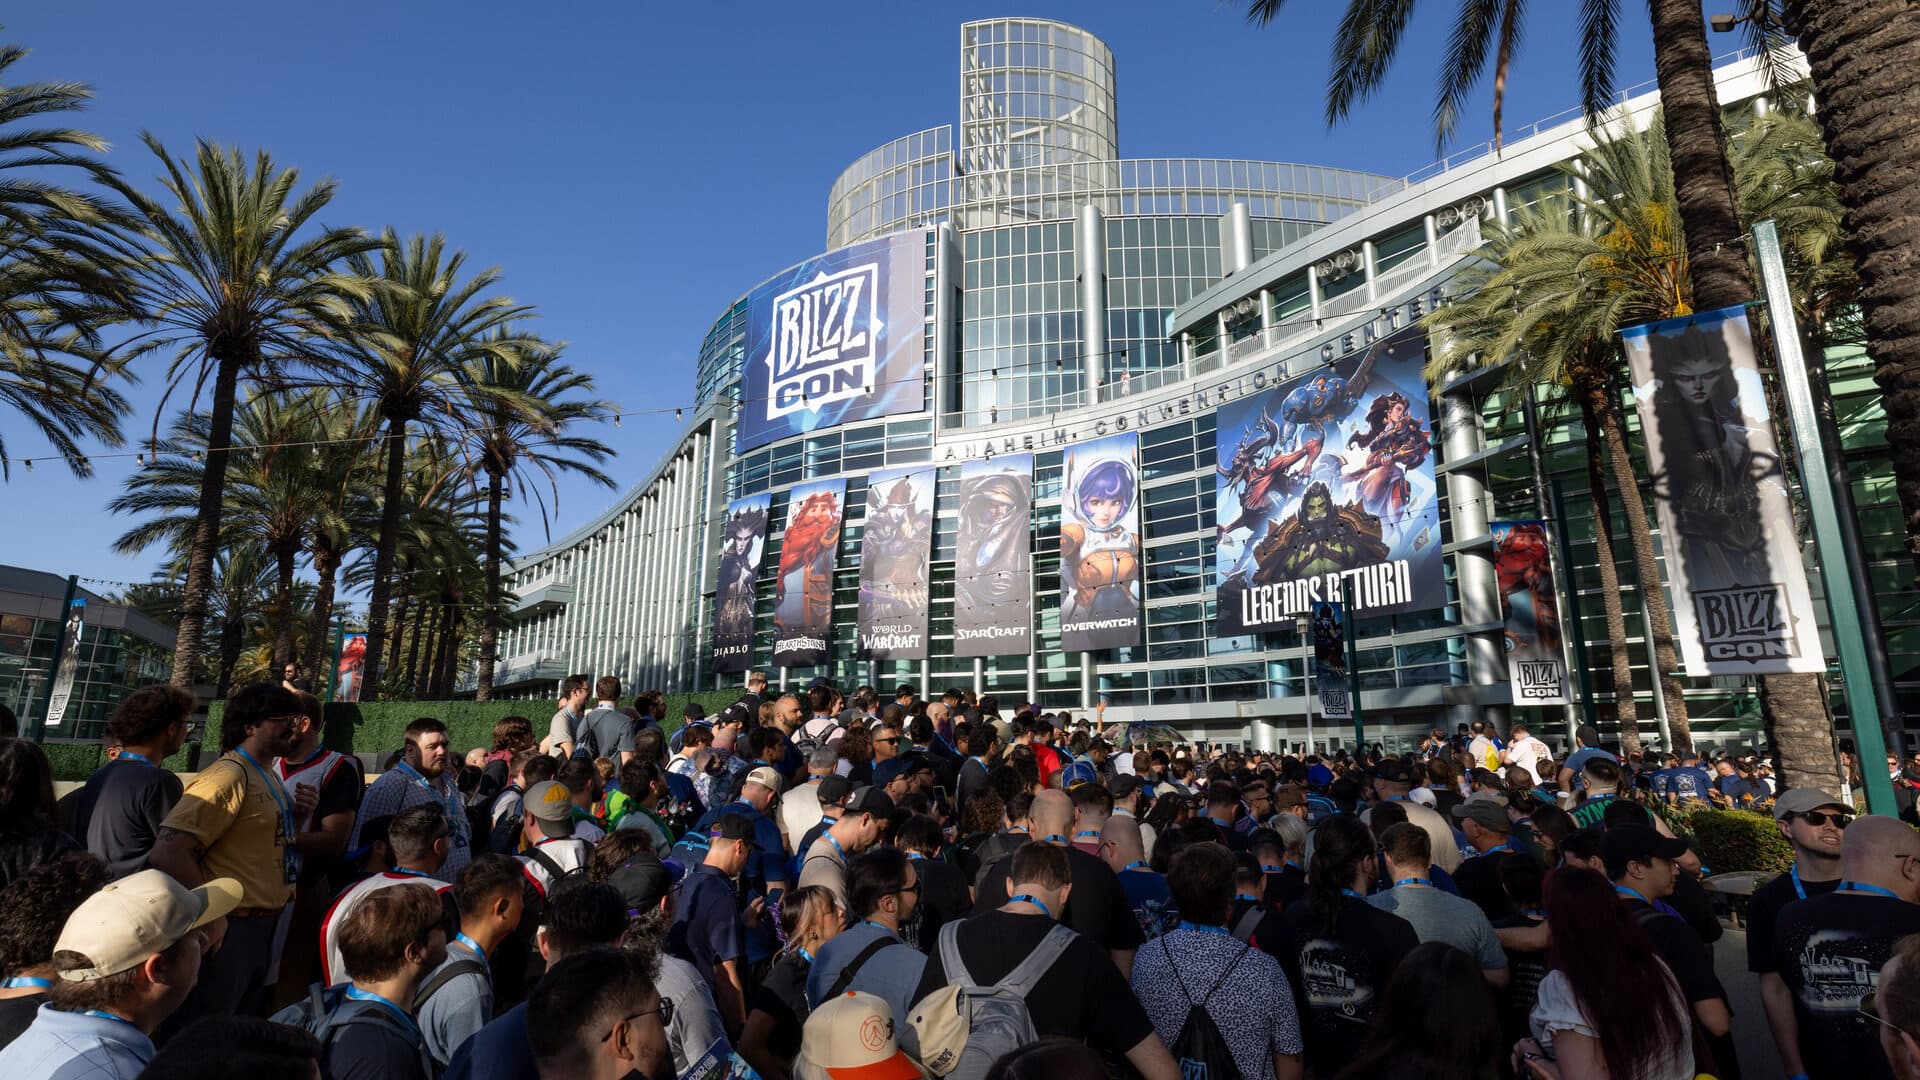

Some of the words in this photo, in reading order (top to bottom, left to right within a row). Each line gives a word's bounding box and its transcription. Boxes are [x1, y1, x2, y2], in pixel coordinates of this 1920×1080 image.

[777, 275, 866, 377] BLIZZ
[944, 427, 1068, 460] ANAHEIM
[1094, 360, 1293, 435] CONVENTION
[1321, 286, 1446, 363] CENTER
[775, 363, 864, 409] CON
[1701, 588, 1788, 639] BLIZZ
[871, 624, 912, 635] WORLD
[1061, 617, 1138, 633] OVERWATCH
[713, 644, 749, 658] DIABLO
[1710, 639, 1793, 659] CON
[1520, 663, 1558, 687] BLIZZ
[1524, 688, 1560, 697] CON
